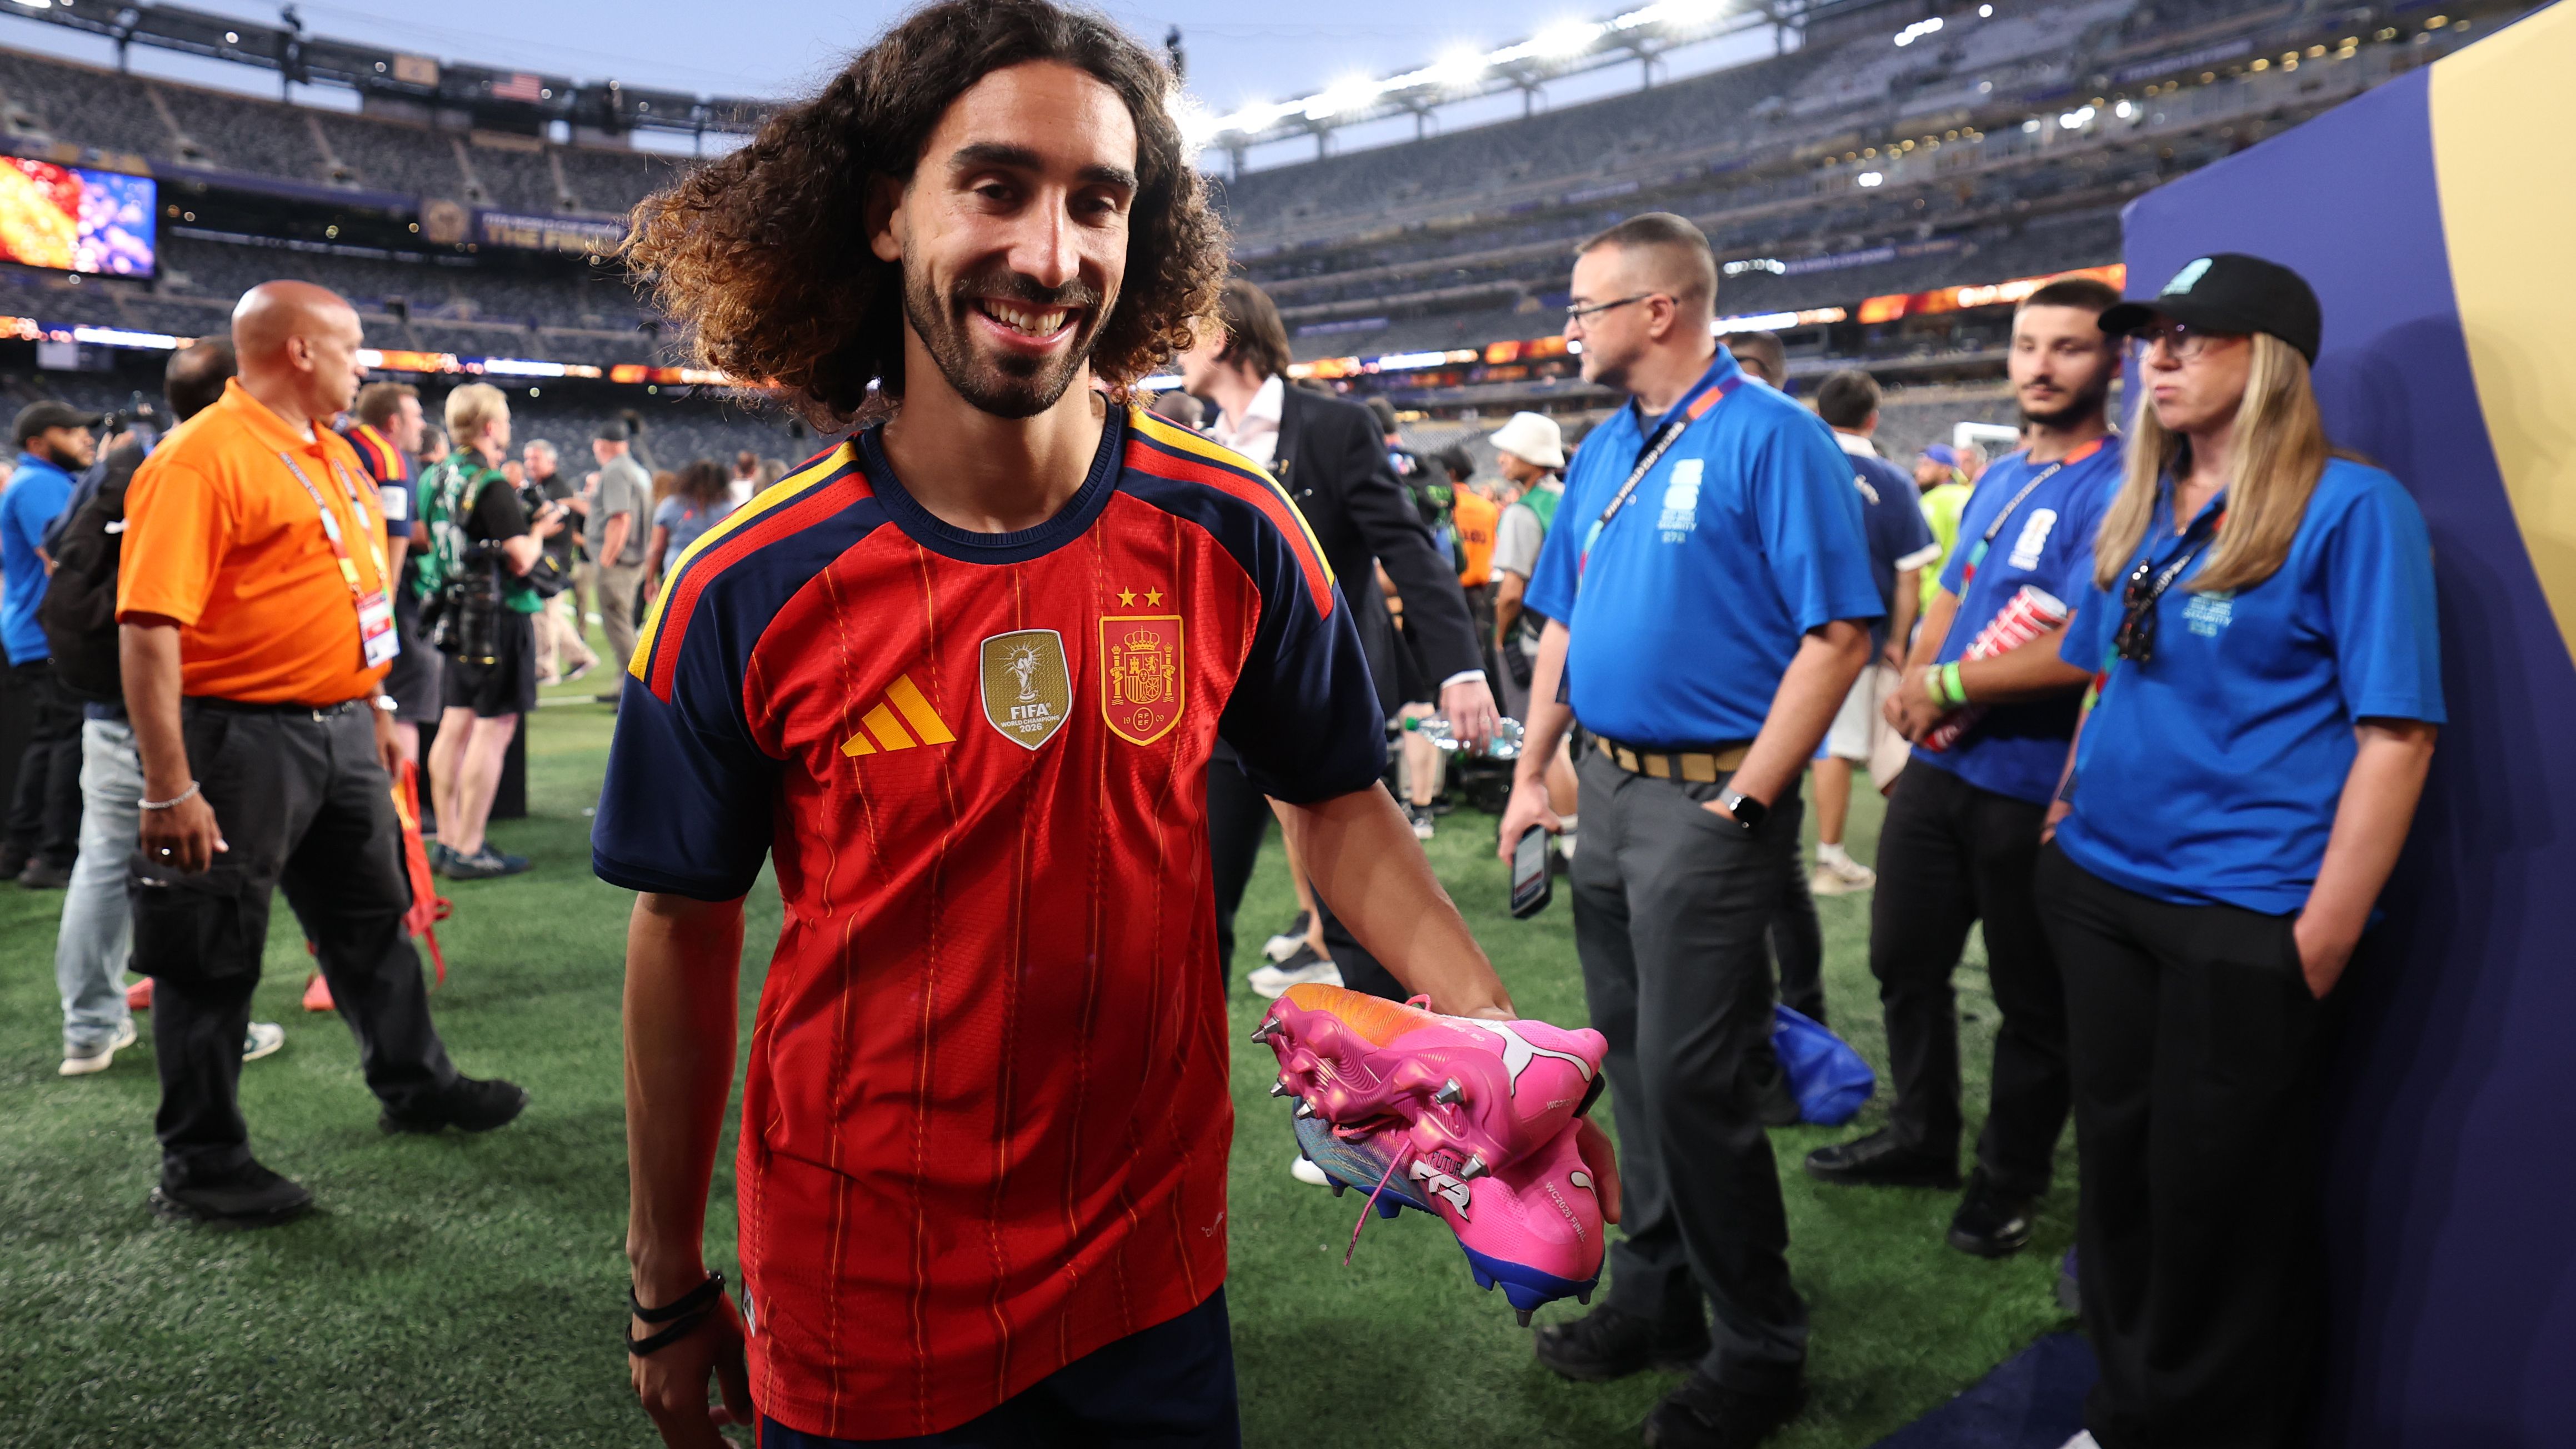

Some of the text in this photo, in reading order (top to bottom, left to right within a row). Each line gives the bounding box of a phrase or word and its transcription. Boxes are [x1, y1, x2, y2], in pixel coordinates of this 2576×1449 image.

[1618, 466, 1645, 501] WORLD
[1639, 449, 1659, 471] CUP
[1020, 723, 1042, 732] 2026
[1023, 715, 1060, 724] CHAMPIONS
[1431, 1151, 1463, 1178] FUTUR
[1545, 1181, 1586, 1242] WC2026 FINAL
